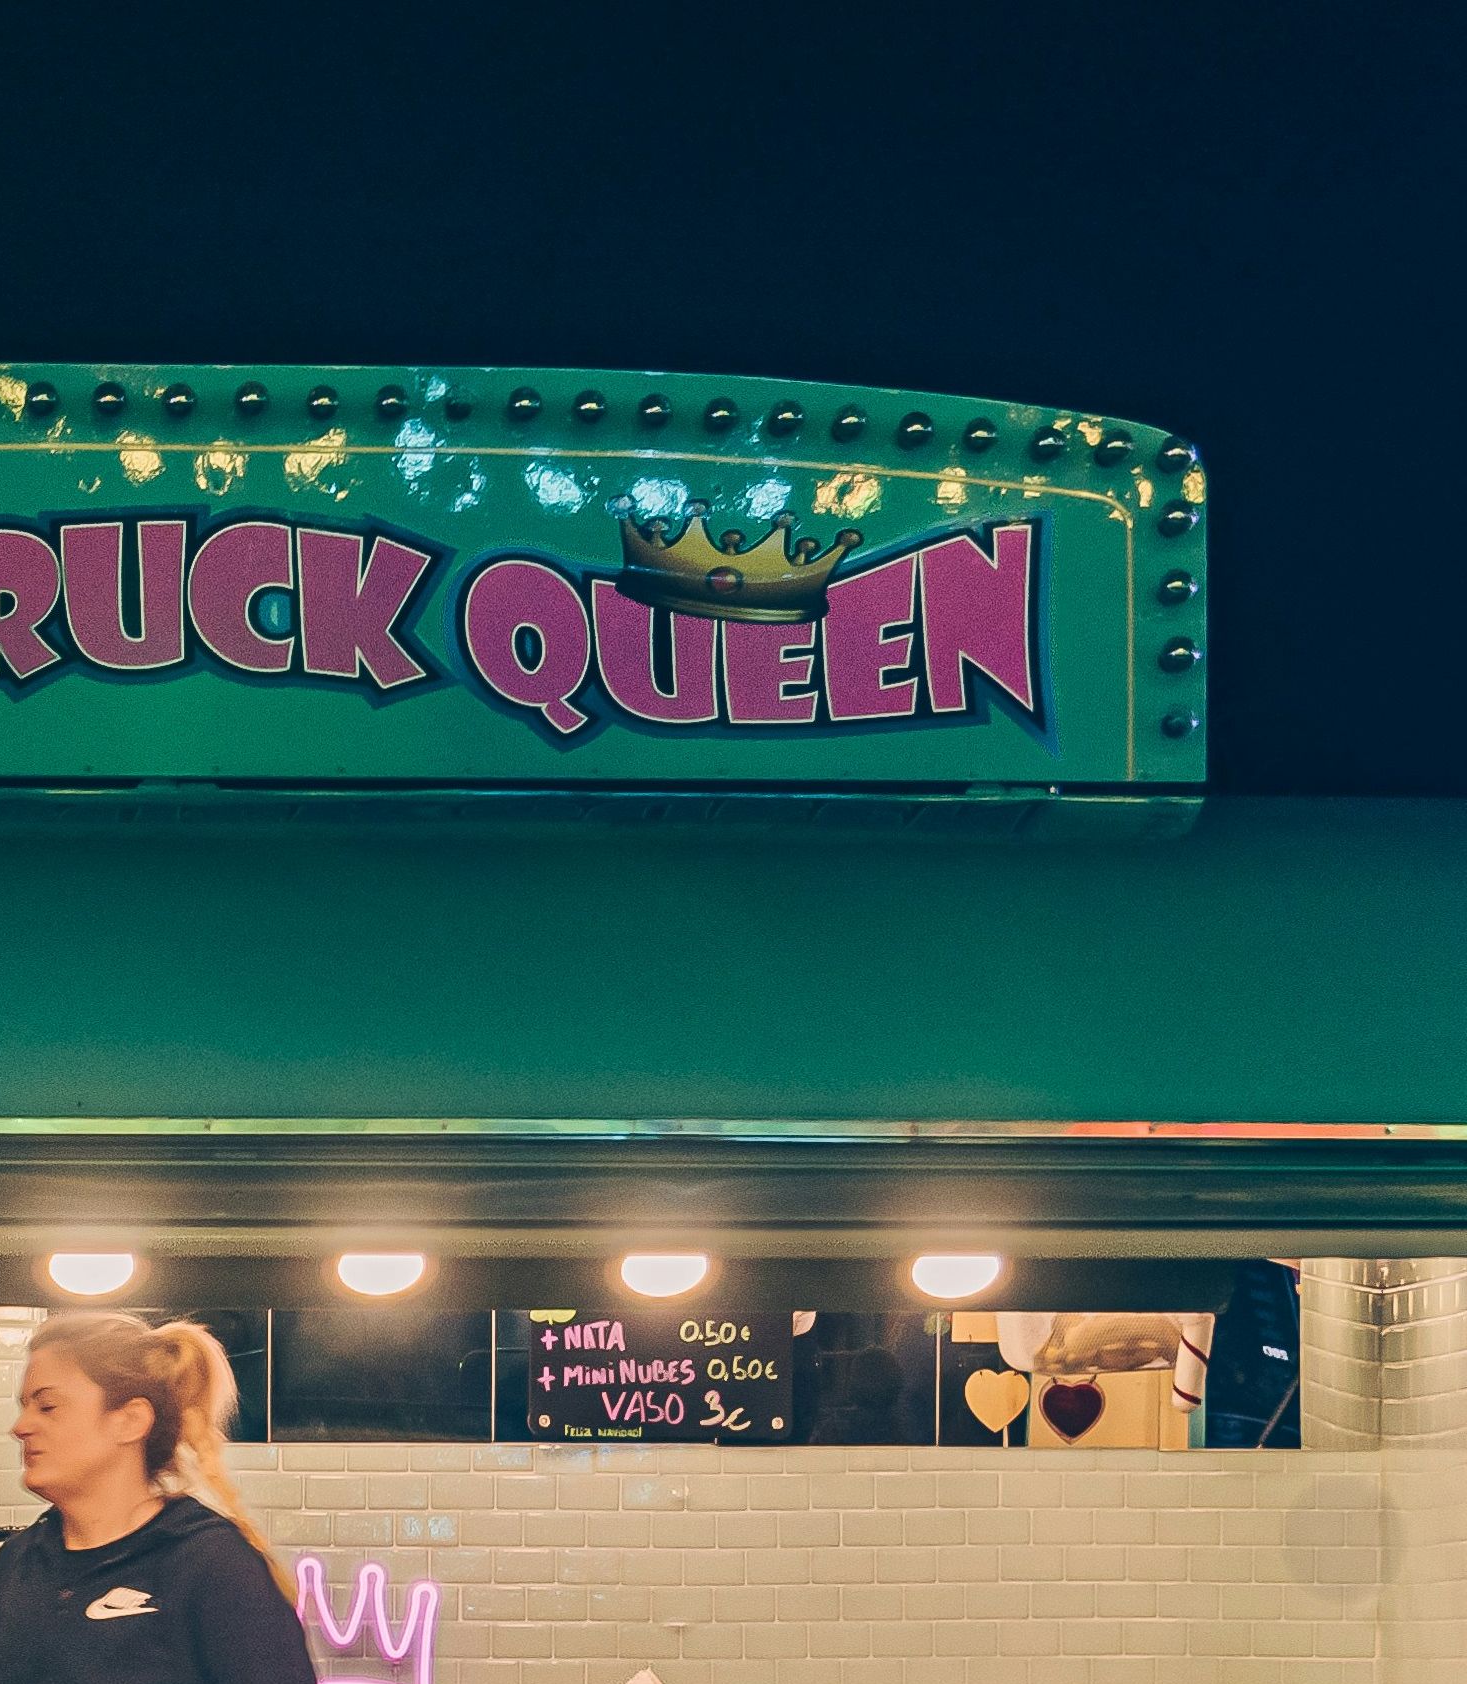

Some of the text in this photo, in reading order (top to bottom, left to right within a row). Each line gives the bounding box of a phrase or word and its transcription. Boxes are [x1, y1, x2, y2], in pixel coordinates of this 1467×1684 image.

[463, 518, 1040, 738] QUEEN
[563, 1320, 626, 1352] NATA
[601, 1390, 685, 1425] VASO
